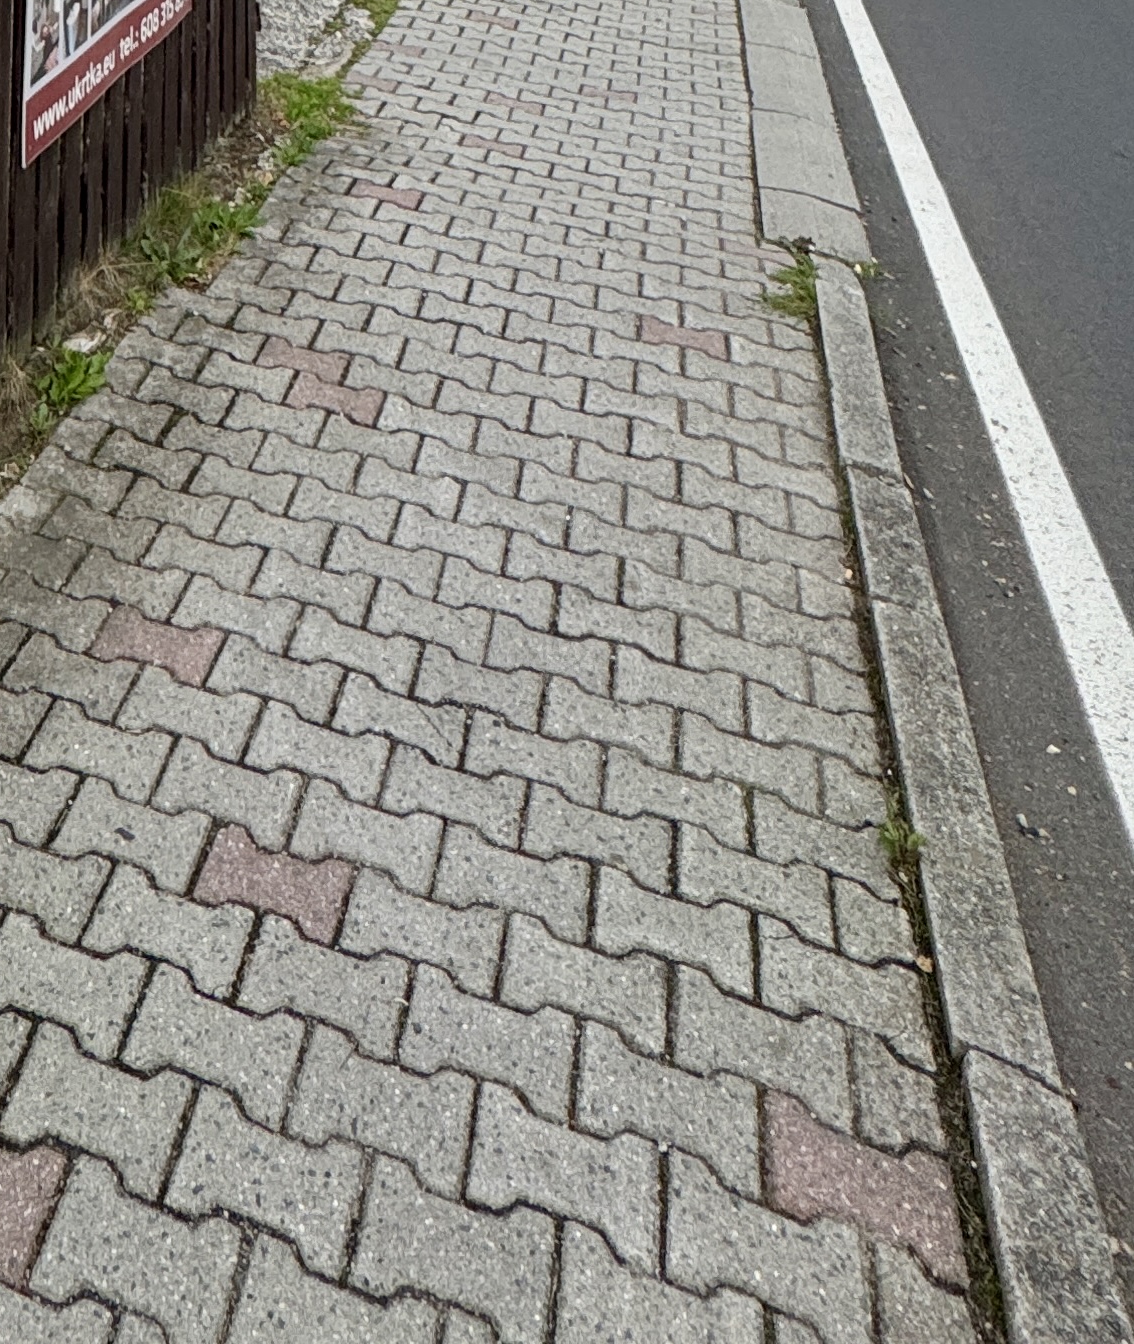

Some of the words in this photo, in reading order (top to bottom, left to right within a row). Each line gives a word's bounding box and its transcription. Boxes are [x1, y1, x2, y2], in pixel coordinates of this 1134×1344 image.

[33, 50, 115, 140] www.ukrtka.eu
[119, 25, 139, 61] tel.:
[140, 7, 159, 43] 608
